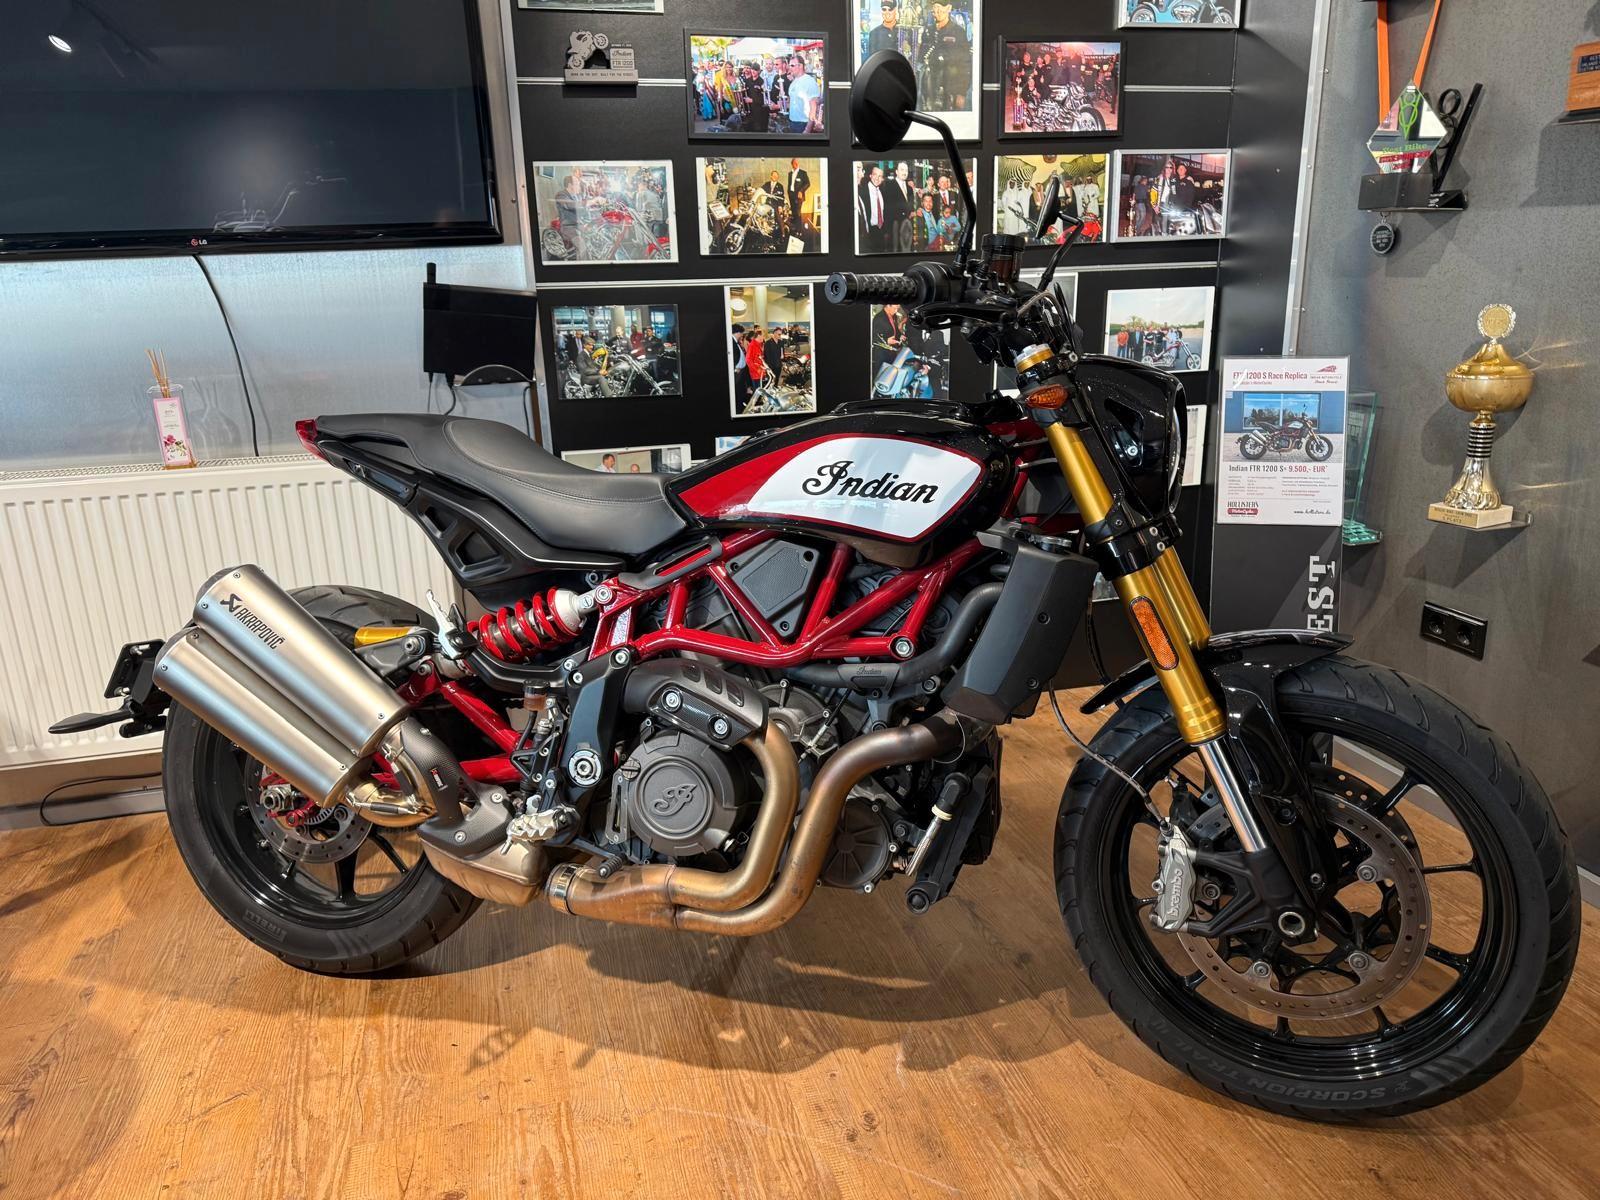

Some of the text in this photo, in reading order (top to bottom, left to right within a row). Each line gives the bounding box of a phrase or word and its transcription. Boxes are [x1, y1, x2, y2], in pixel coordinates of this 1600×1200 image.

[1246, 371, 1262, 380] 1200
[1262, 371, 1267, 380] S
[1268, 371, 1284, 380] Race
[1284, 371, 1308, 381] Replica
[801, 460, 940, 504] Indian
[1166, 868, 1183, 918] brembo
[244, 908, 289, 942] PIRELLI
[1174, 1035, 1240, 1080] TRAIL
[1247, 1077, 1387, 1101] SCORPION
